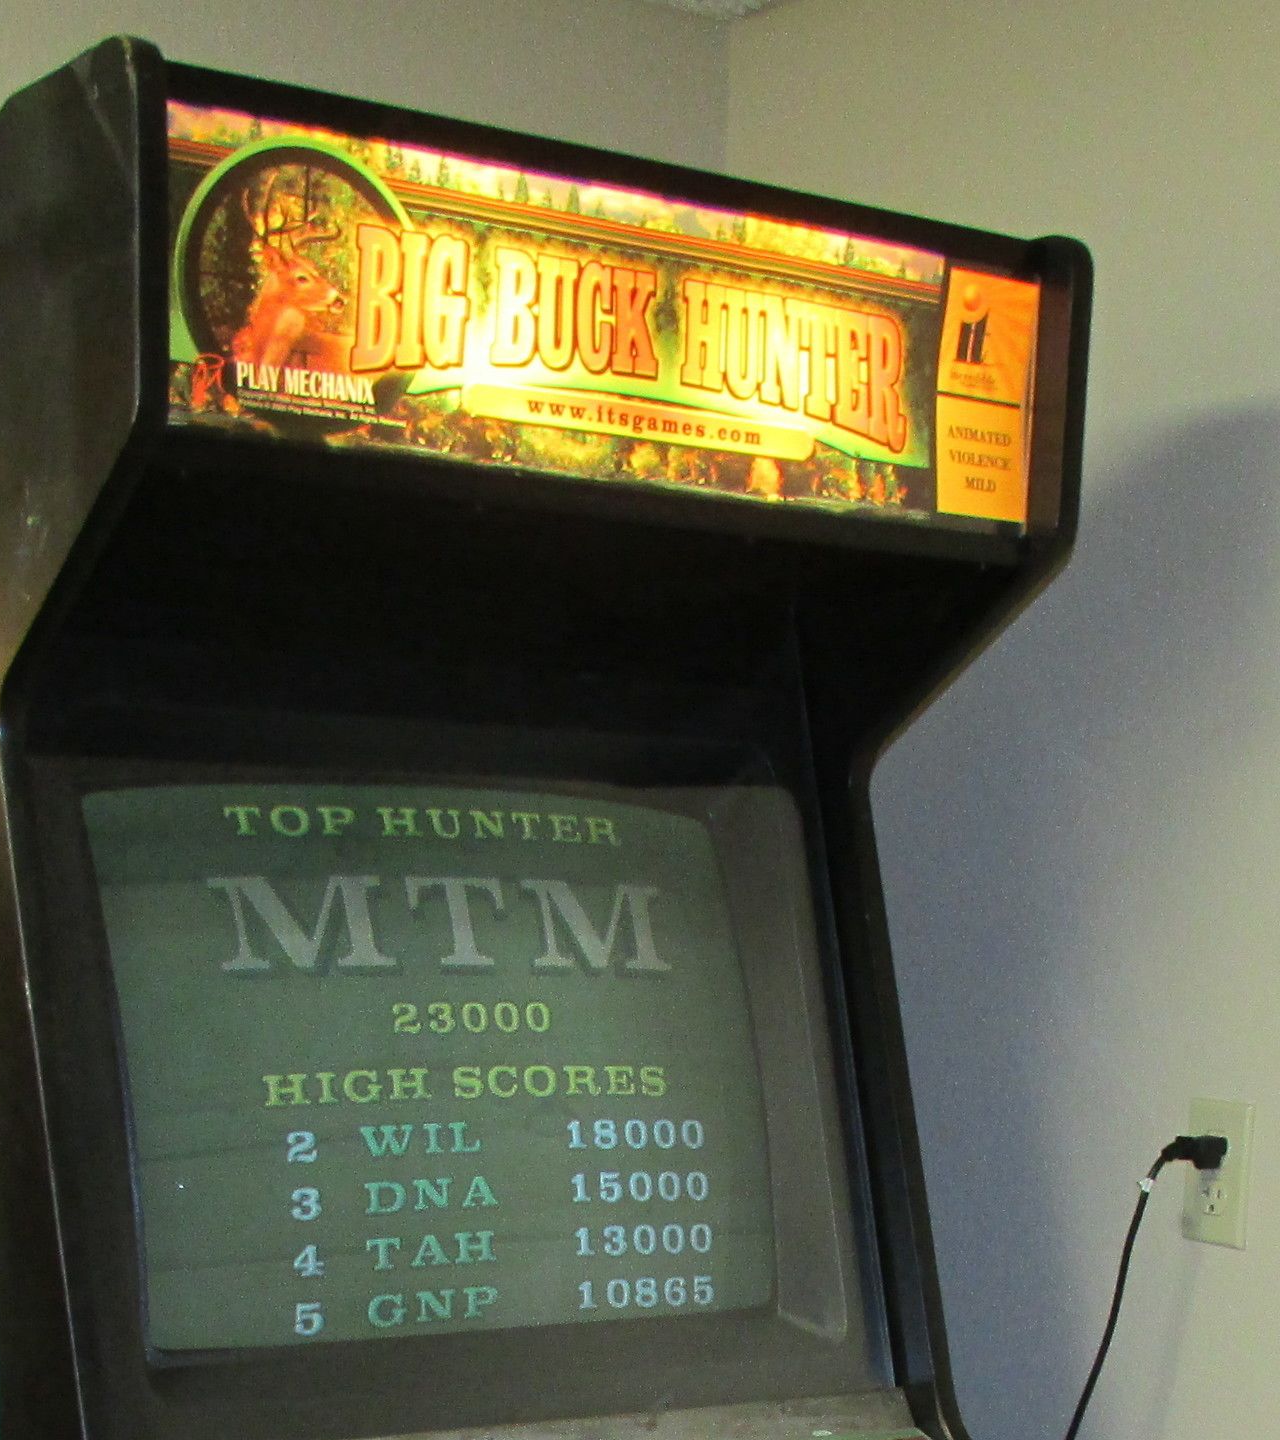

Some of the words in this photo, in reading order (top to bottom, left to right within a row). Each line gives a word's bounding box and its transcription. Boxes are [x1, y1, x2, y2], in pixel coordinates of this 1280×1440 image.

[349, 223, 470, 373] BIG
[489, 244, 659, 379] BUCK
[679, 278, 908, 454] HUNTER
[236, 361, 280, 393] PLAY
[283, 367, 376, 405] MECHANIX
[527, 397, 762, 446] www.itsgames.com
[948, 425, 1012, 447] ANIMATED
[949, 449, 1012, 471] VIOLENCE
[965, 476, 997, 493] MILD
[223, 805, 356, 837] TOP
[377, 806, 620, 845] HUNTER
[206, 874, 672, 973] MTM
[391, 1001, 552, 1034] 23000
[262, 1067, 434, 1107] HIGH
[452, 1064, 669, 1099] SCORES
[286, 1130, 318, 1163] 2
[360, 1121, 482, 1157] WIL
[566, 1118, 705, 1150] 18000
[291, 1187, 322, 1221] 3
[364, 1175, 499, 1214] DNA
[571, 1171, 709, 1203] 15000
[293, 1245, 324, 1278] 4
[365, 1230, 498, 1271] TAH
[575, 1223, 713, 1257] 13000
[294, 1302, 325, 1335] 5
[367, 1285, 499, 1328] GNP
[577, 1275, 715, 1310] 10865
